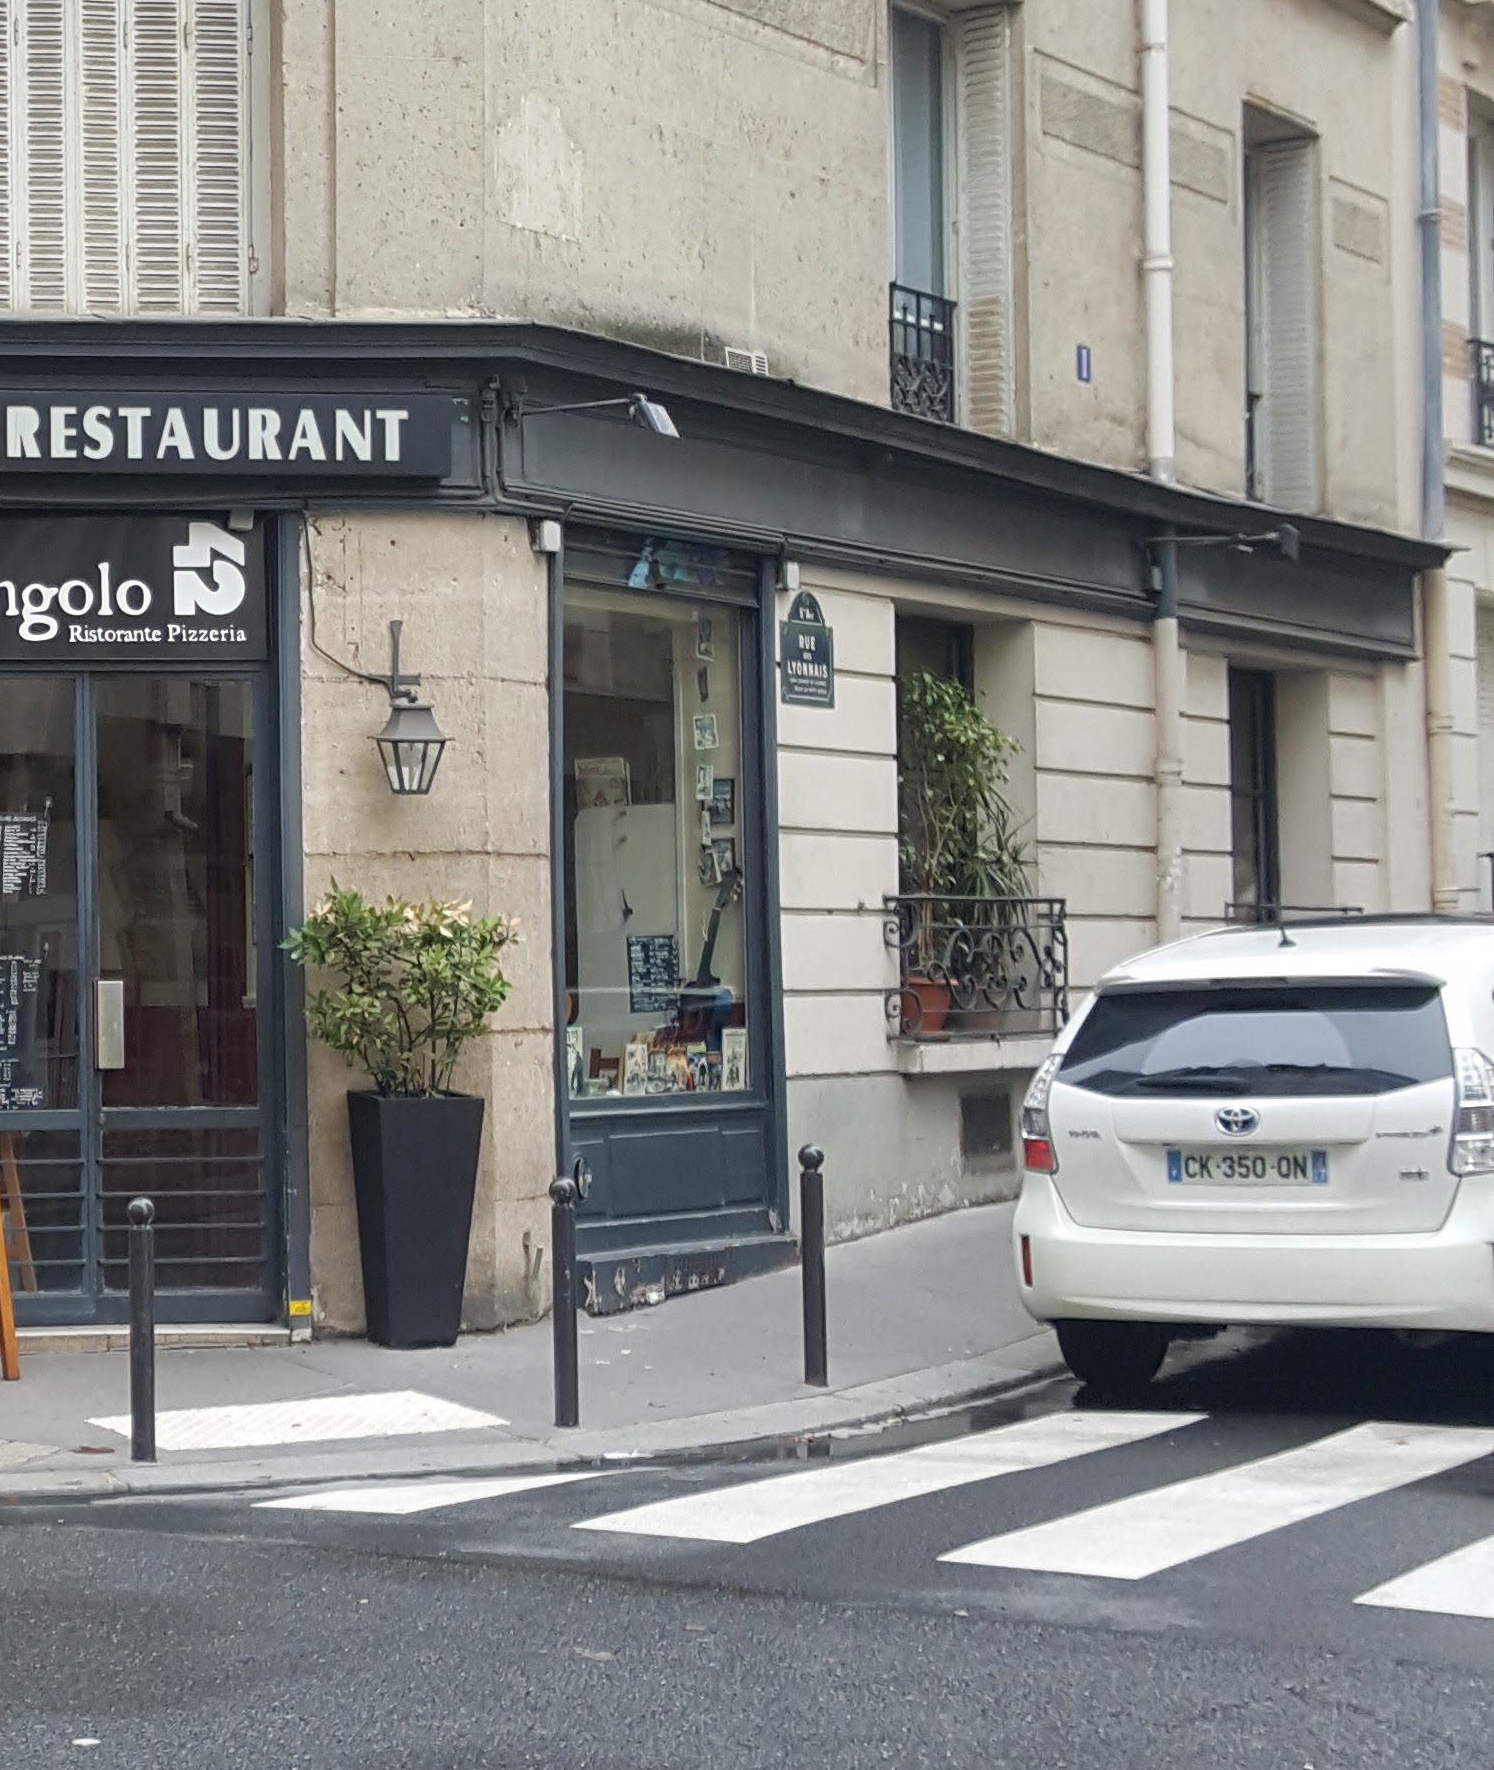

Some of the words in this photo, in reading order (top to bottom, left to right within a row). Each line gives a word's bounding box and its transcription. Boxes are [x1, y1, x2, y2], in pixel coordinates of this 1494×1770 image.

[6, 405, 409, 461] RESTAURANT
[68, 624, 162, 643] Ristorante
[167, 624, 247, 643] Pizzeria
[798, 634, 816, 651] RUE
[787, 660, 828, 679] LYONNAIS
